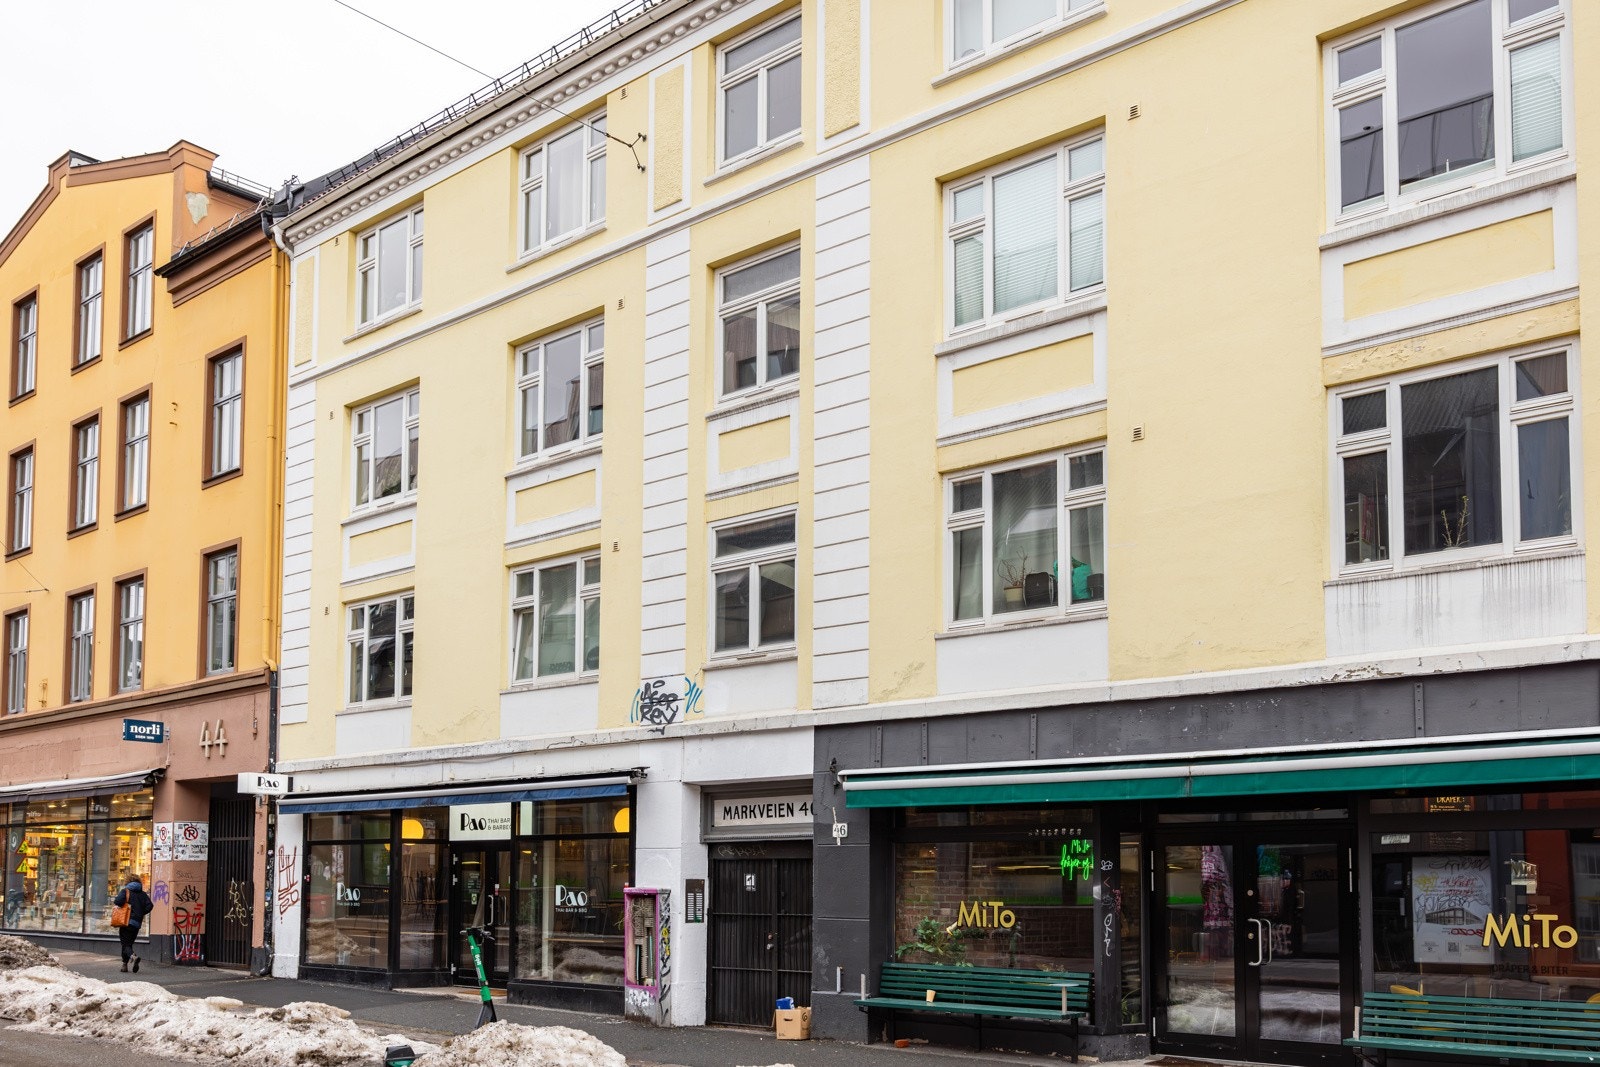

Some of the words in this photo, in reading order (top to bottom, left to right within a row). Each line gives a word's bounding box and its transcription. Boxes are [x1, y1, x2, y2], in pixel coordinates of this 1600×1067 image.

[129, 723, 160, 735] norli
[199, 719, 229, 758] 44
[257, 776, 280, 788] Pao
[723, 803, 794, 820] MARKVEIEN
[460, 812, 487, 831] Pao
[336, 882, 361, 901] Pao
[555, 884, 588, 907] Pao
[957, 900, 1016, 928] Mi.To
[1482, 912, 1578, 949] Mi.To
